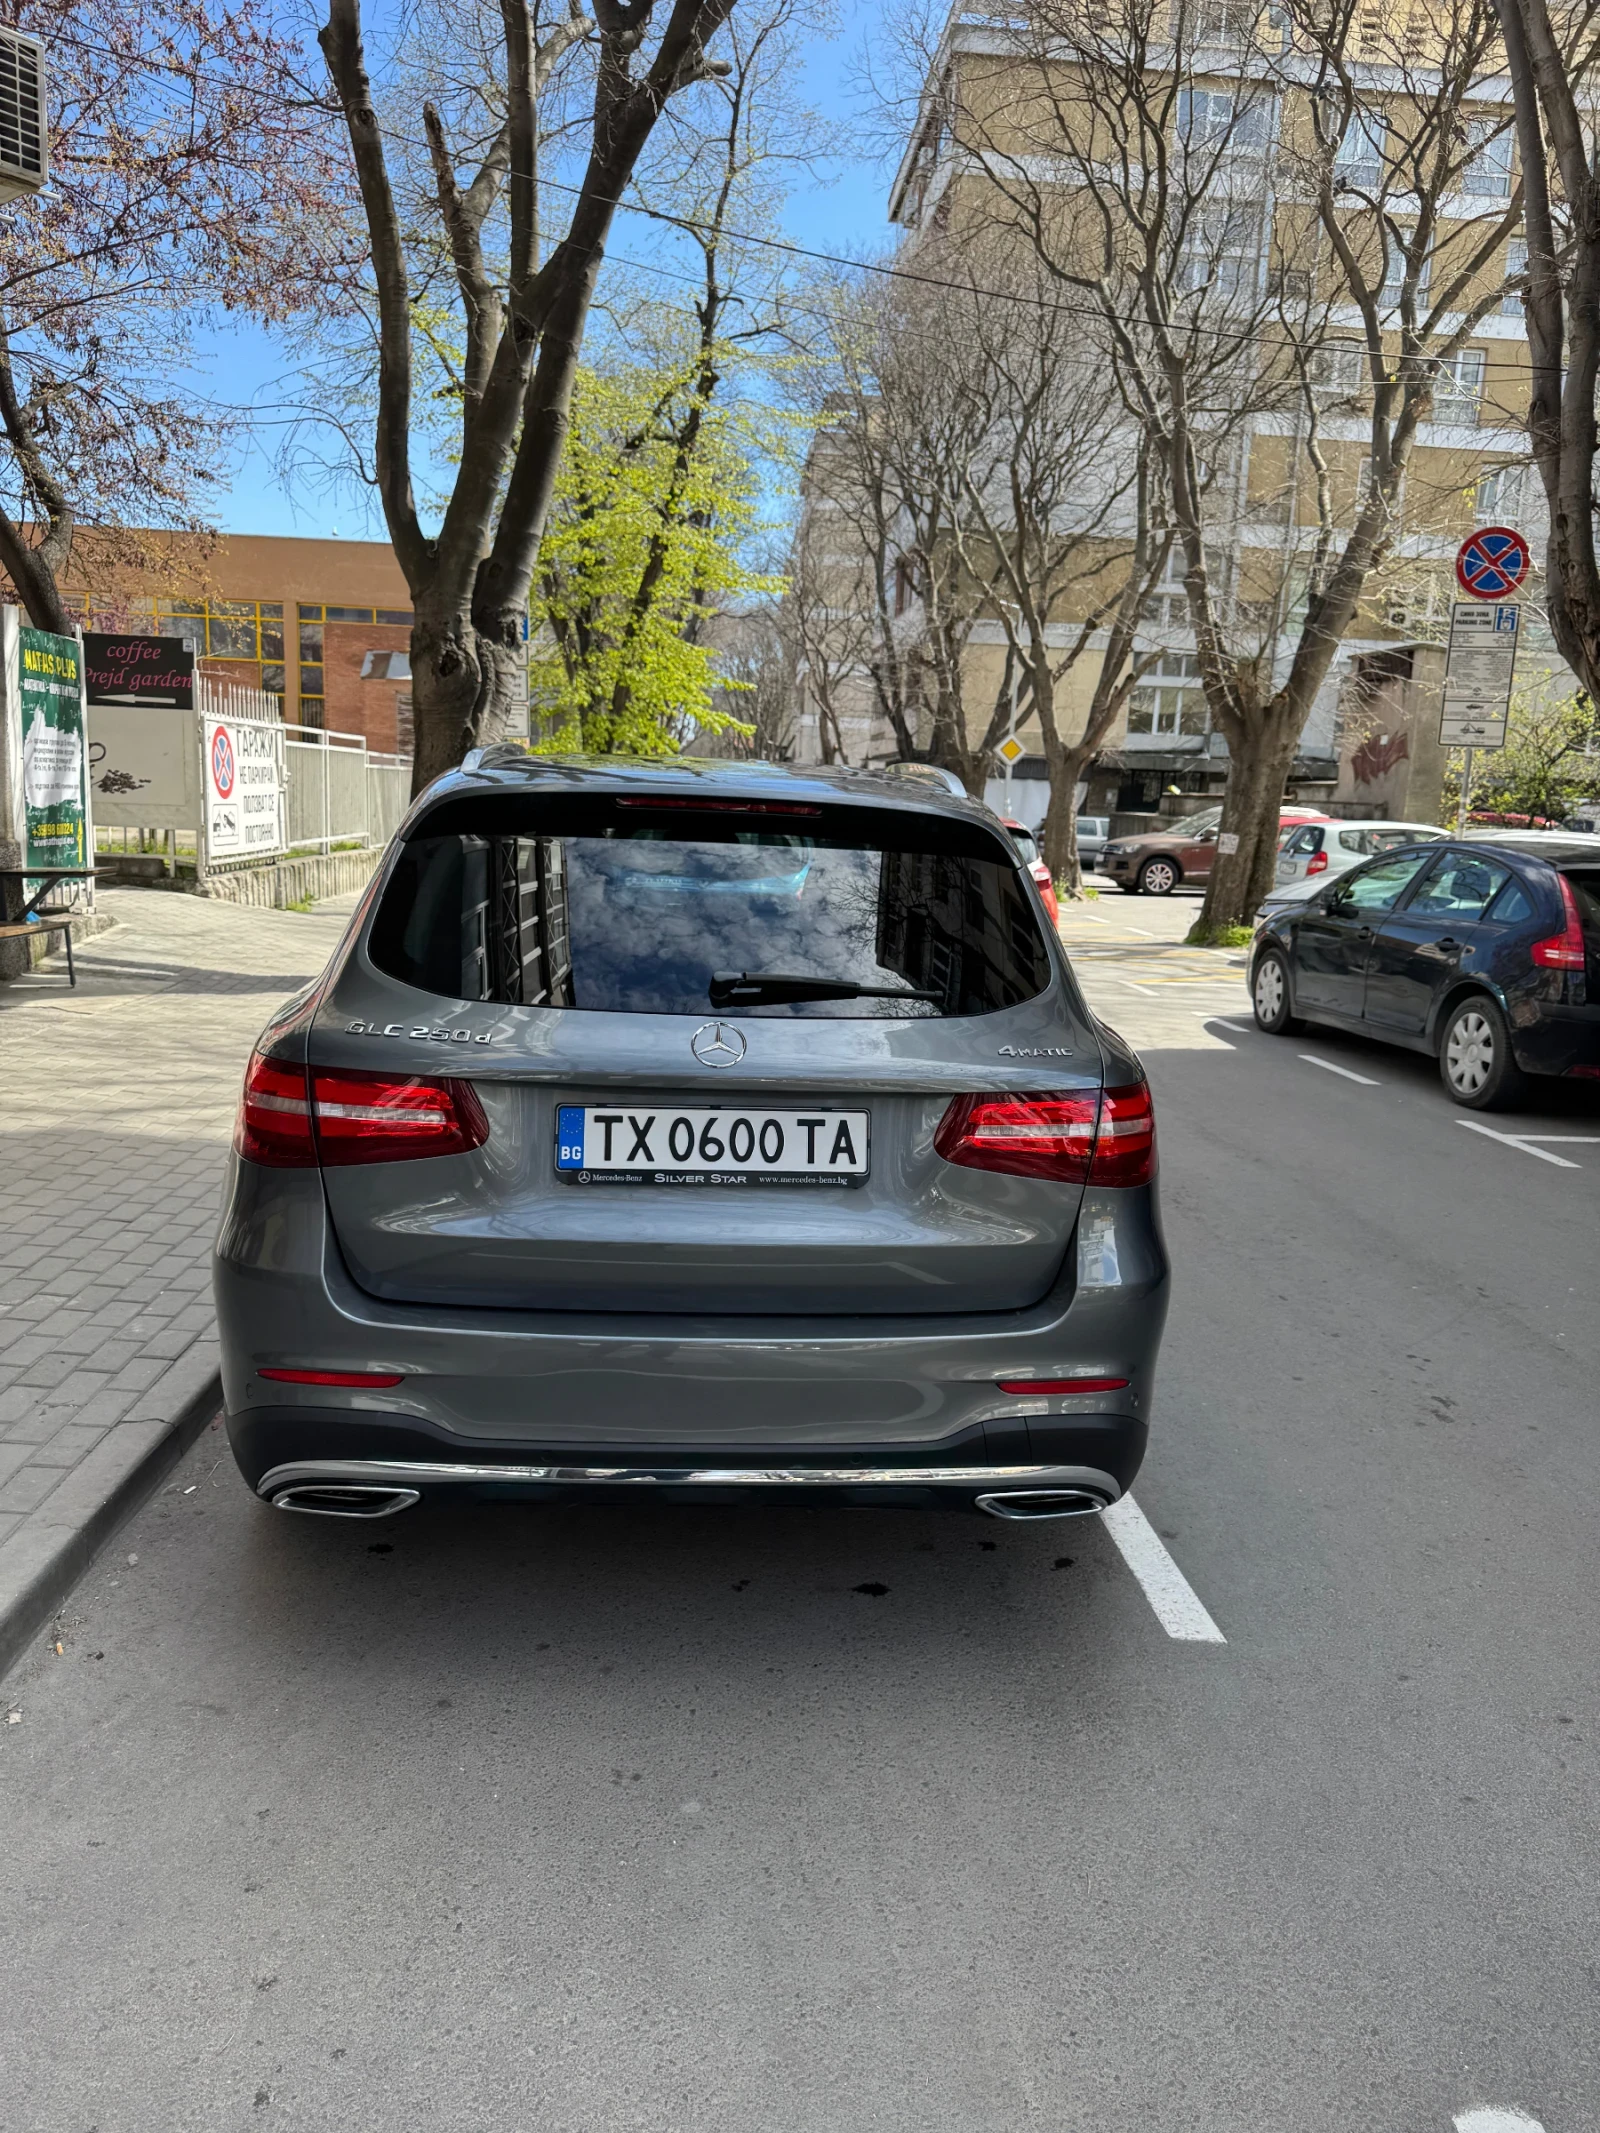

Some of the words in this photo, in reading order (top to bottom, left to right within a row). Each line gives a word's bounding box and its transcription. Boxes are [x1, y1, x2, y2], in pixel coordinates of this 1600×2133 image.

[106, 640, 162, 664] coffee
[24, 648, 54, 675] MATHS
[55, 656, 77, 680] PLUS
[128, 669, 193, 691] garden
[236, 729, 274, 758] ГАРАЖИ
[239, 765, 247, 784] НЕ
[243, 794, 267, 814] ПОЛЗВАТ
[268, 793, 275, 812] СЕ
[245, 822, 275, 844] ПОСТОЯННО
[344, 1020, 404, 1037] GLC
[998, 1044, 1074, 1057] 4MATIC
[594, 1115, 656, 1162] TX
[668, 1116, 785, 1164] 0600
[796, 1118, 857, 1165] TA
[560, 1145, 582, 1161] BG
[592, 1173, 643, 1182] Mercedes-Benz
[758, 1175, 848, 1186] www.mercedes-benz.bg
